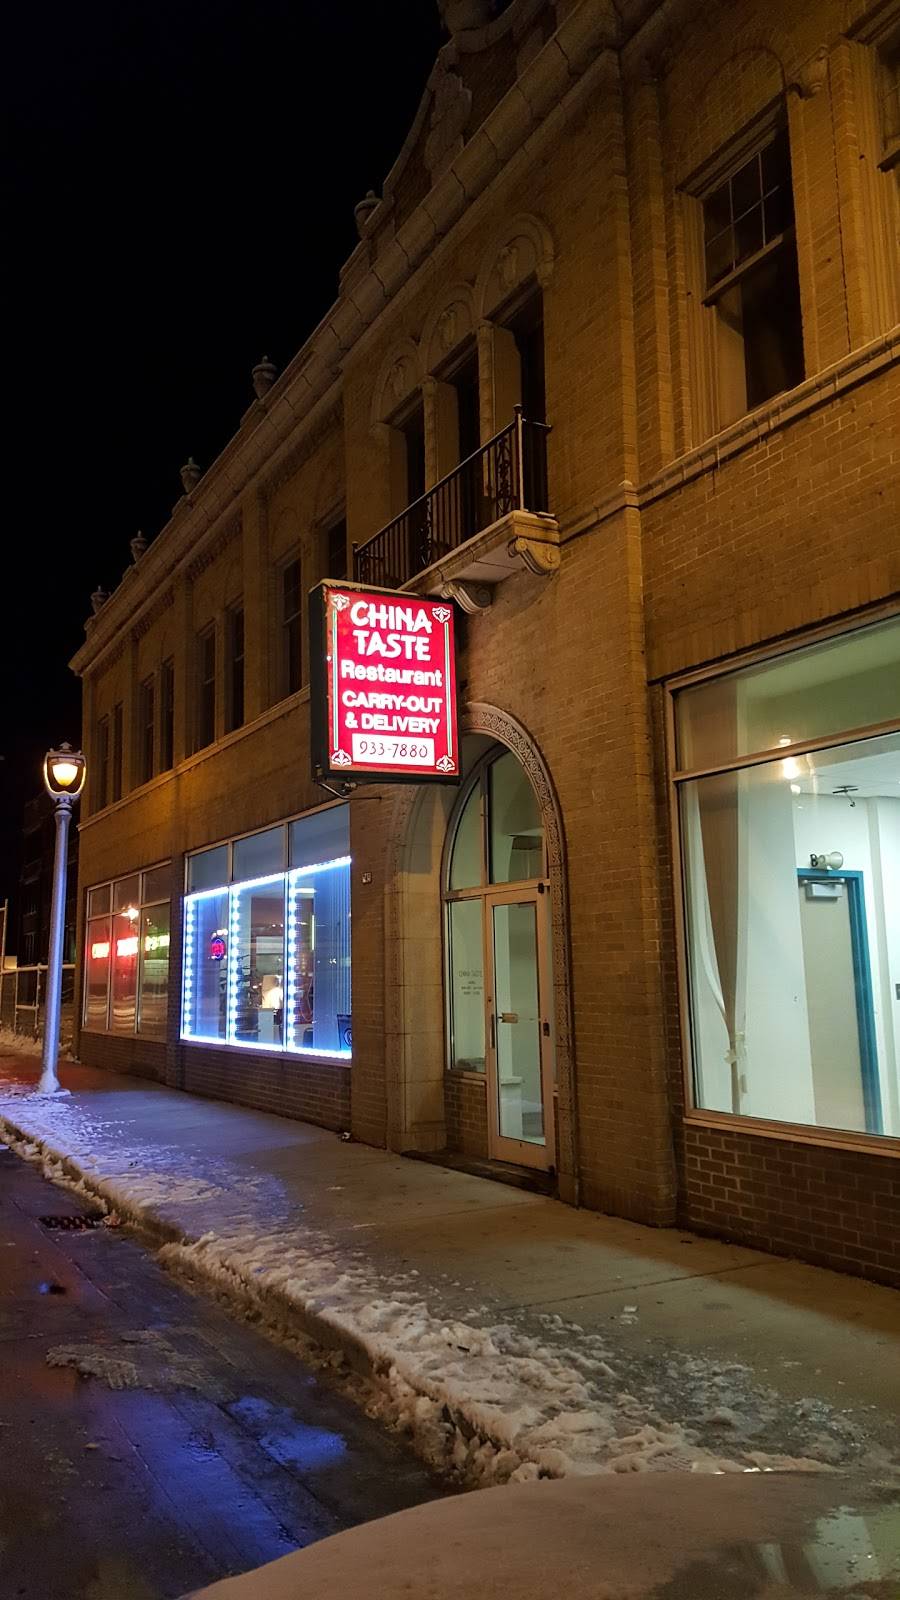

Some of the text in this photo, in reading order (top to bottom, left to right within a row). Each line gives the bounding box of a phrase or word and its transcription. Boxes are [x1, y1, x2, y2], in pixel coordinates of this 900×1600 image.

[350, 601, 432, 634] CHINA
[352, 630, 431, 661] TASTE
[341, 659, 443, 687] Restaurant
[341, 690, 443, 713] CARRY-OUT
[345, 712, 440, 734] & DELIVERY
[359, 740, 428, 758] 933-7880
